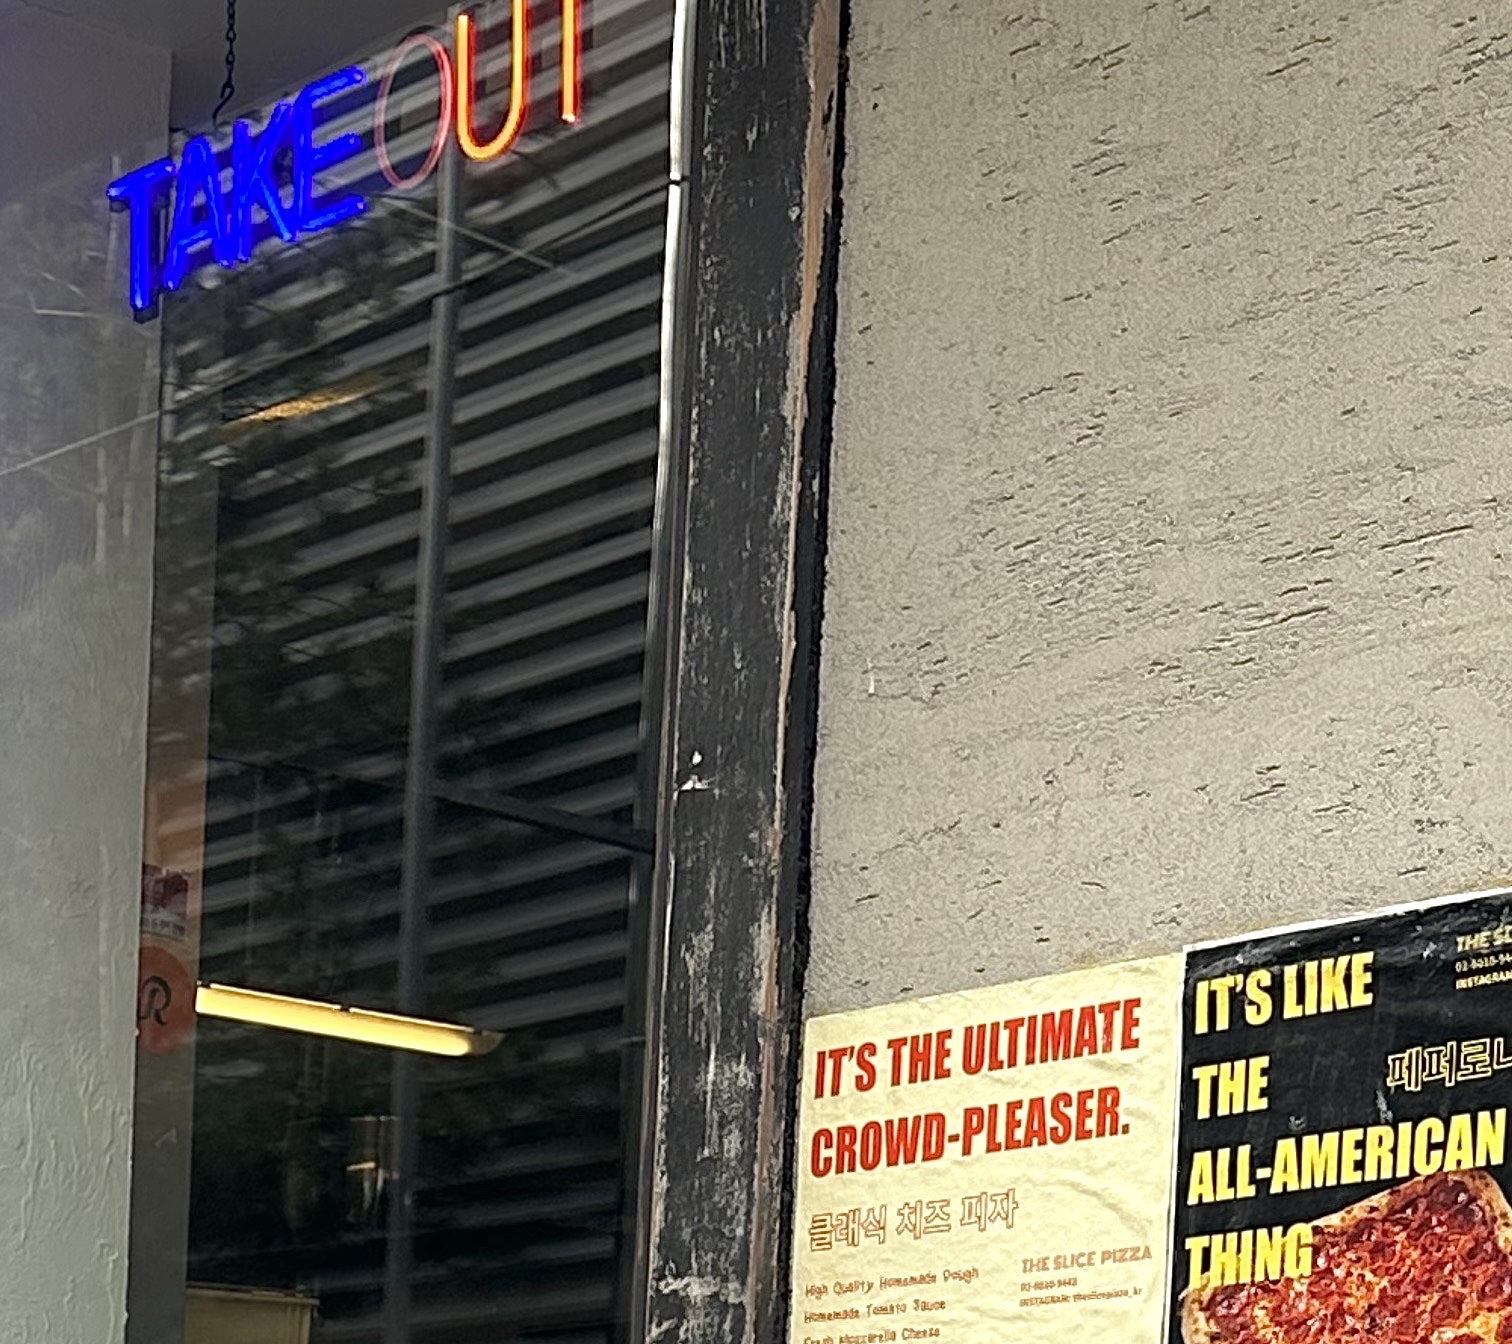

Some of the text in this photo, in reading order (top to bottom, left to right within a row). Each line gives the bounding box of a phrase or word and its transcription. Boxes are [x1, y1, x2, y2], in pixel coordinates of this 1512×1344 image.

[107, 66, 368, 310] TAKE
[1193, 951, 1376, 1037] IT'S LIKE
[814, 998, 1142, 1099] IT'S THE ULTIMATE
[1192, 1057, 1271, 1119] THE
[811, 1084, 1131, 1179] CROWD-PLEASER.
[1187, 1109, 1507, 1207] ALL-AMERICAN
[808, 1189, 1019, 1252] 클래식 치즈 피자
[1021, 1245, 1152, 1274] THE SLICE PIZZA
[1186, 1221, 1317, 1291] THING
